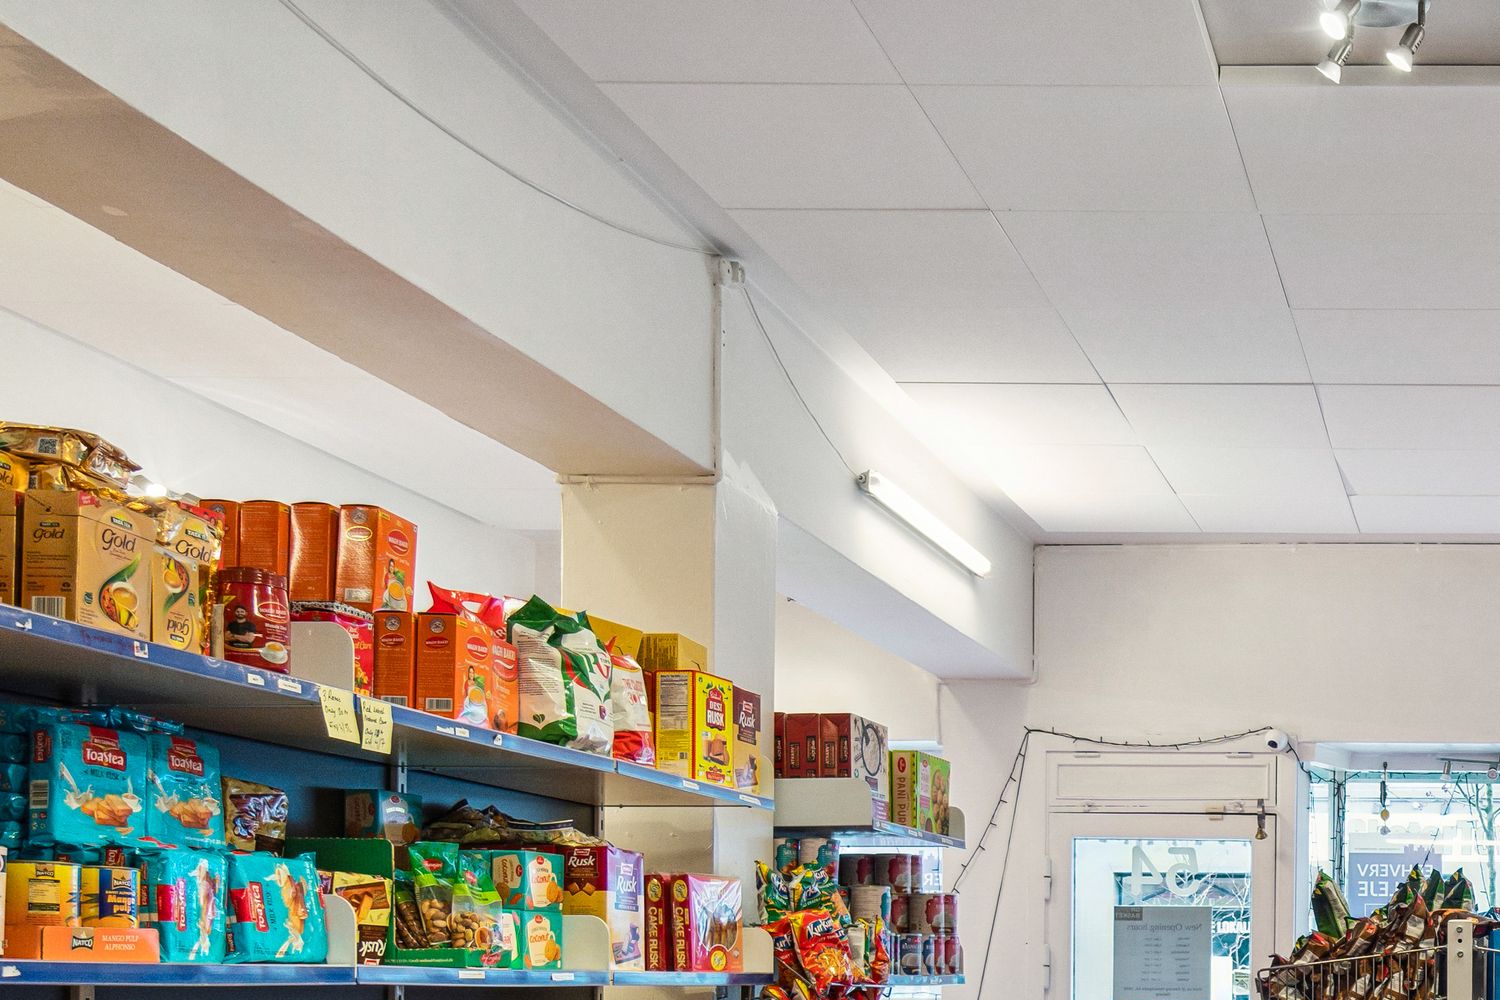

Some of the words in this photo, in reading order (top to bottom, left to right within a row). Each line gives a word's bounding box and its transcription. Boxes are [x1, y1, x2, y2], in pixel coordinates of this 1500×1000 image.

[32, 528, 65, 543] Gold
[101, 527, 137, 553] Gold
[175, 539, 213, 564] Gold
[706, 711, 725, 727] RUSK
[739, 711, 756, 729] Rusk
[898, 776, 906, 801] PANI
[568, 856, 596, 867] Rusk
[616, 875, 637, 893] Rusk
[648, 906, 659, 941] CAKE
[675, 906, 686, 941] CAKE
[72, 938, 93, 949] NATCO
[102, 934, 124, 943] MANGO
[125, 934, 140, 942] PULP
[104, 942, 136, 951] ALPHONSO
[529, 935, 550, 944] coconut
[359, 940, 387, 956] Rusk
[648, 940, 660, 969] RUSK
[675, 940, 687, 968] RUSK
